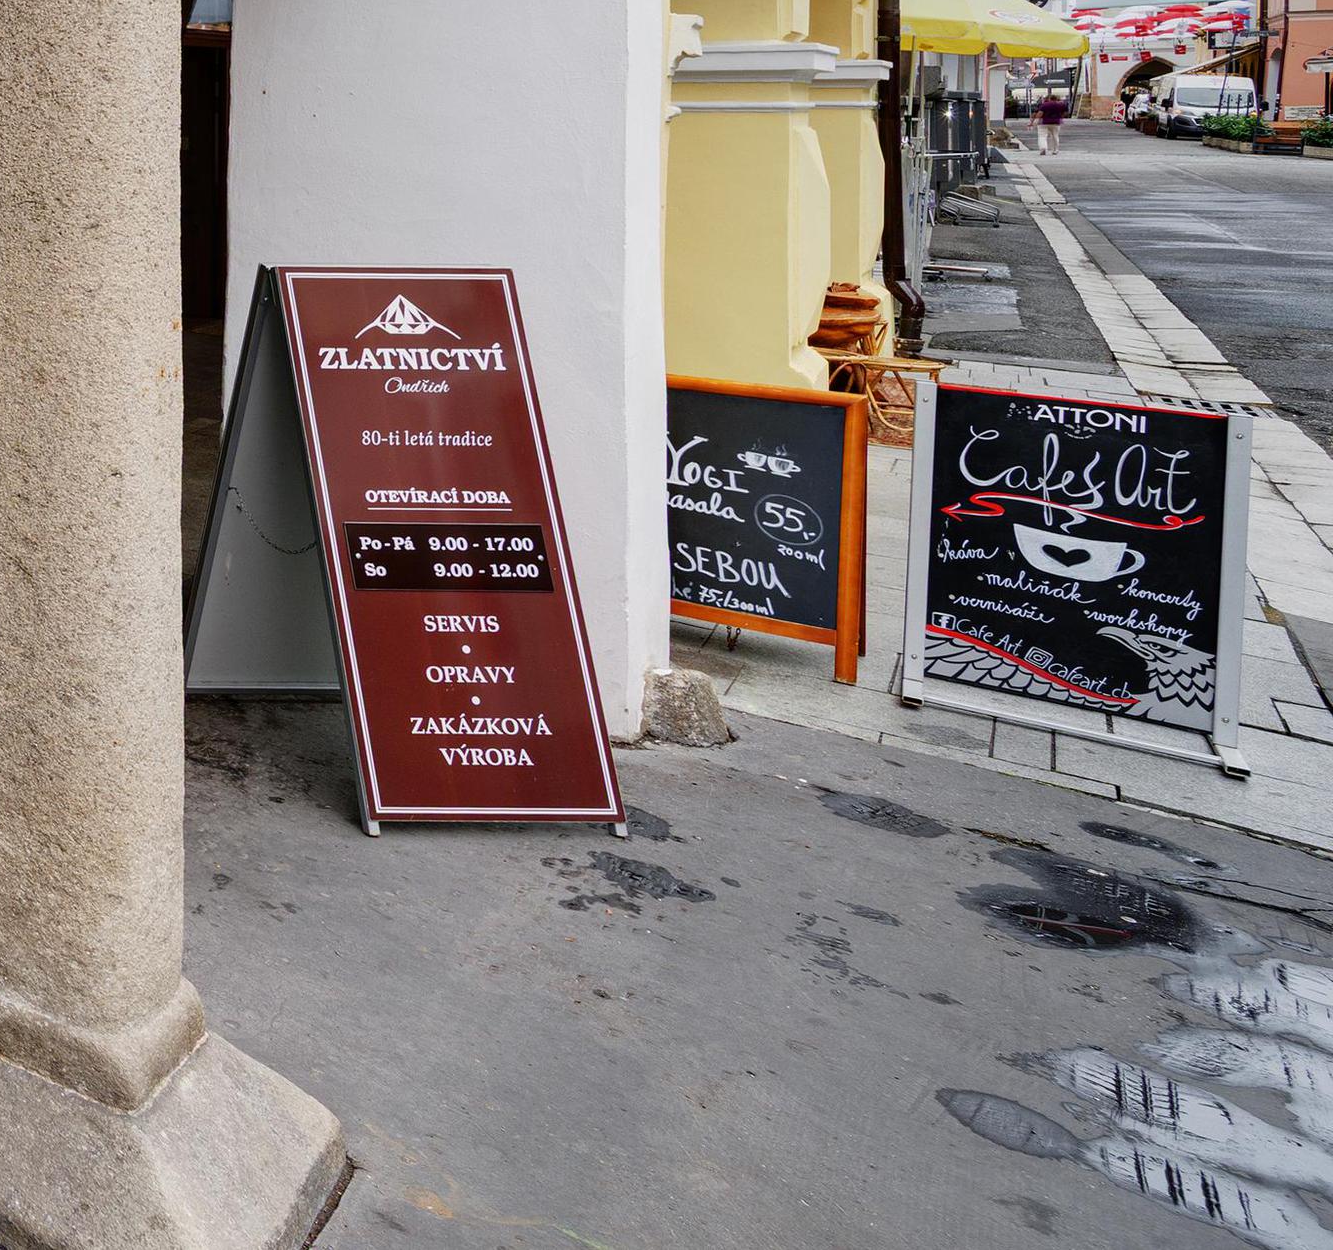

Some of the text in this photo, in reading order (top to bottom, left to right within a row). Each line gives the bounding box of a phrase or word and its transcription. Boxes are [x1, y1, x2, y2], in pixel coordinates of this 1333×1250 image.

[319, 342, 507, 371] ZLATNICTVÍ
[384, 377, 450, 393] Ondřich
[362, 430, 493, 447] 80-ti letá tradice
[667, 432, 749, 494] YOGI
[1115, 444, 1197, 514] Art
[365, 487, 511, 504] OTEVÍRACÍ DOBA
[428, 537, 468, 551] 9.00
[484, 537, 534, 552] 17.00
[943, 539, 999, 563] káva
[364, 563, 387, 577] So
[433, 563, 473, 578] 9.00
[489, 563, 539, 578] 12.00
[674, 542, 792, 598] SEBOU
[954, 594, 1055, 623] vernisáže
[1122, 578, 1203, 620] koncerty
[423, 615, 500, 632] SERVIS
[1089, 609, 1193, 647] workshopy
[957, 618, 993, 642] Cafe
[997, 634, 1024, 656] Art
[426, 665, 515, 683] OPRAVY
[1048, 662, 1132, 699] cafeart_cb
[410, 713, 553, 736] ZAKÁZKOVÁ
[439, 743, 535, 766] VÝROBA
